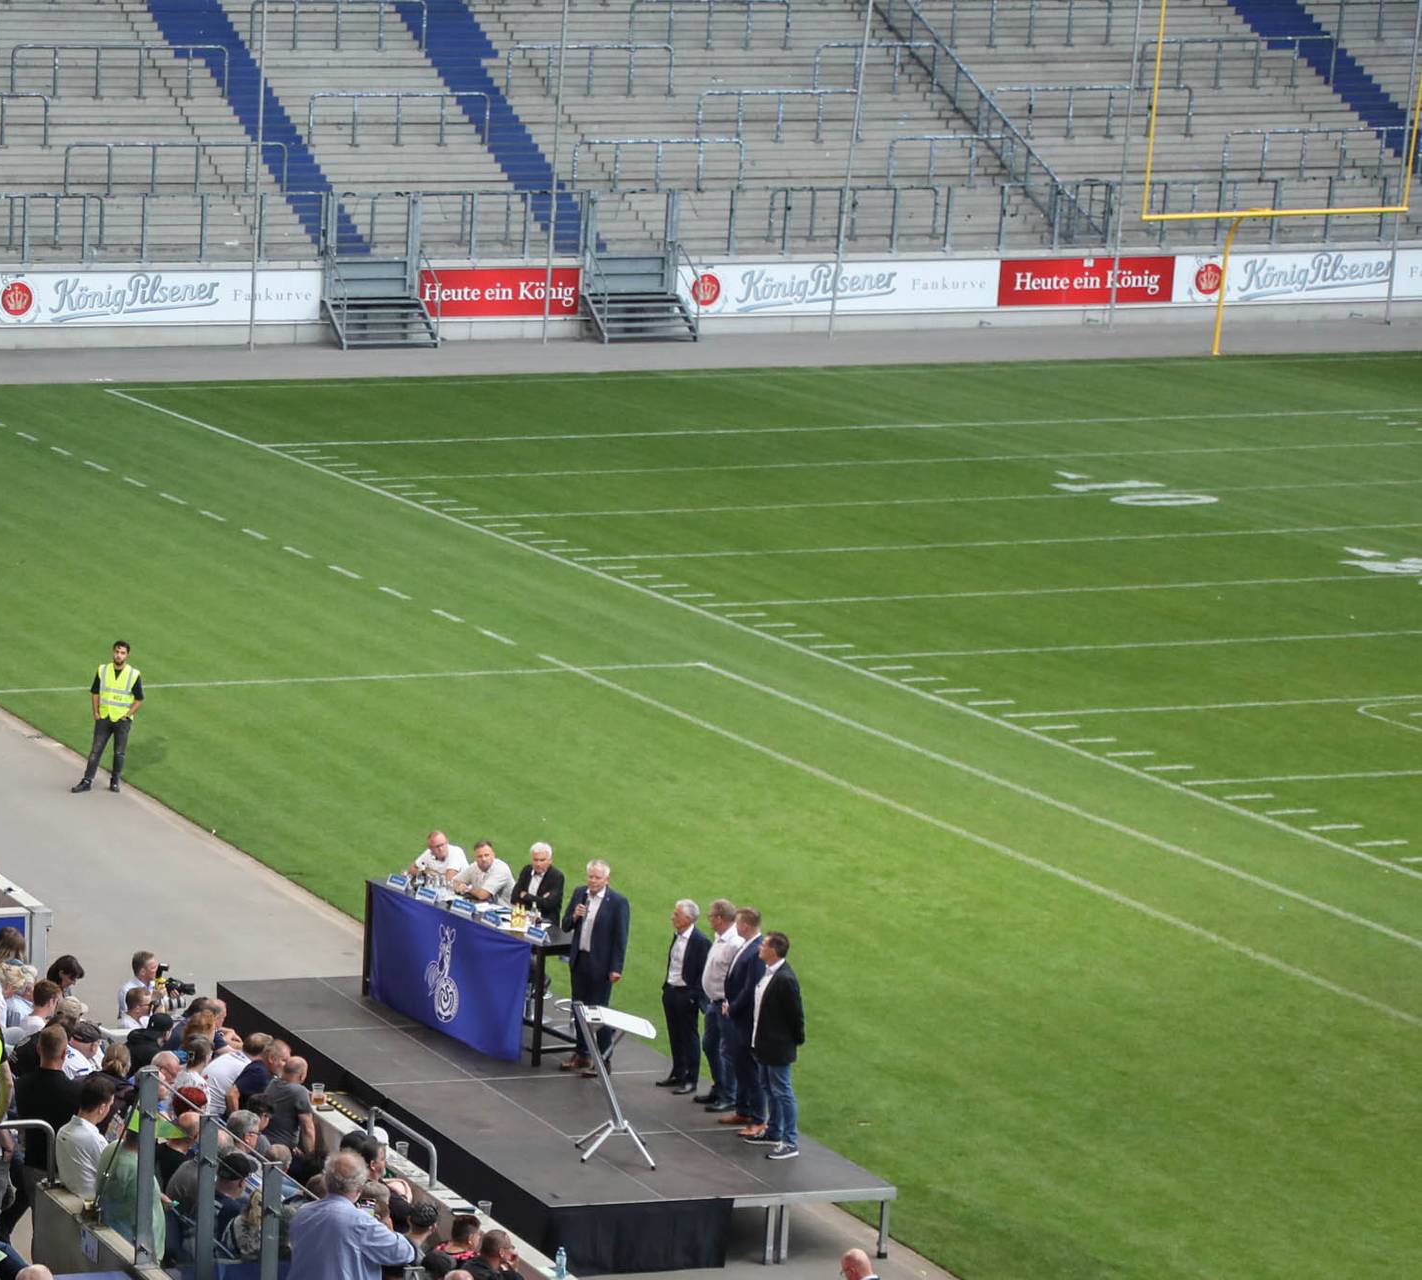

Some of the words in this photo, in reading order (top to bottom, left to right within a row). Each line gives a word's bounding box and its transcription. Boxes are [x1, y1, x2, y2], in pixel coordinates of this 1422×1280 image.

[736, 269, 809, 304] König
[911, 276, 987, 290] Fankurve
[1014, 272, 1070, 291] Heute
[1073, 272, 1101, 289] ein
[1105, 270, 1161, 295] König
[1237, 257, 1310, 292] König
[49, 278, 128, 314] König
[125, 273, 220, 306] Pilsener
[233, 287, 312, 301] Fankurve
[423, 283, 481, 302] Heute
[484, 283, 513, 300] ein
[518, 282, 575, 307] König
